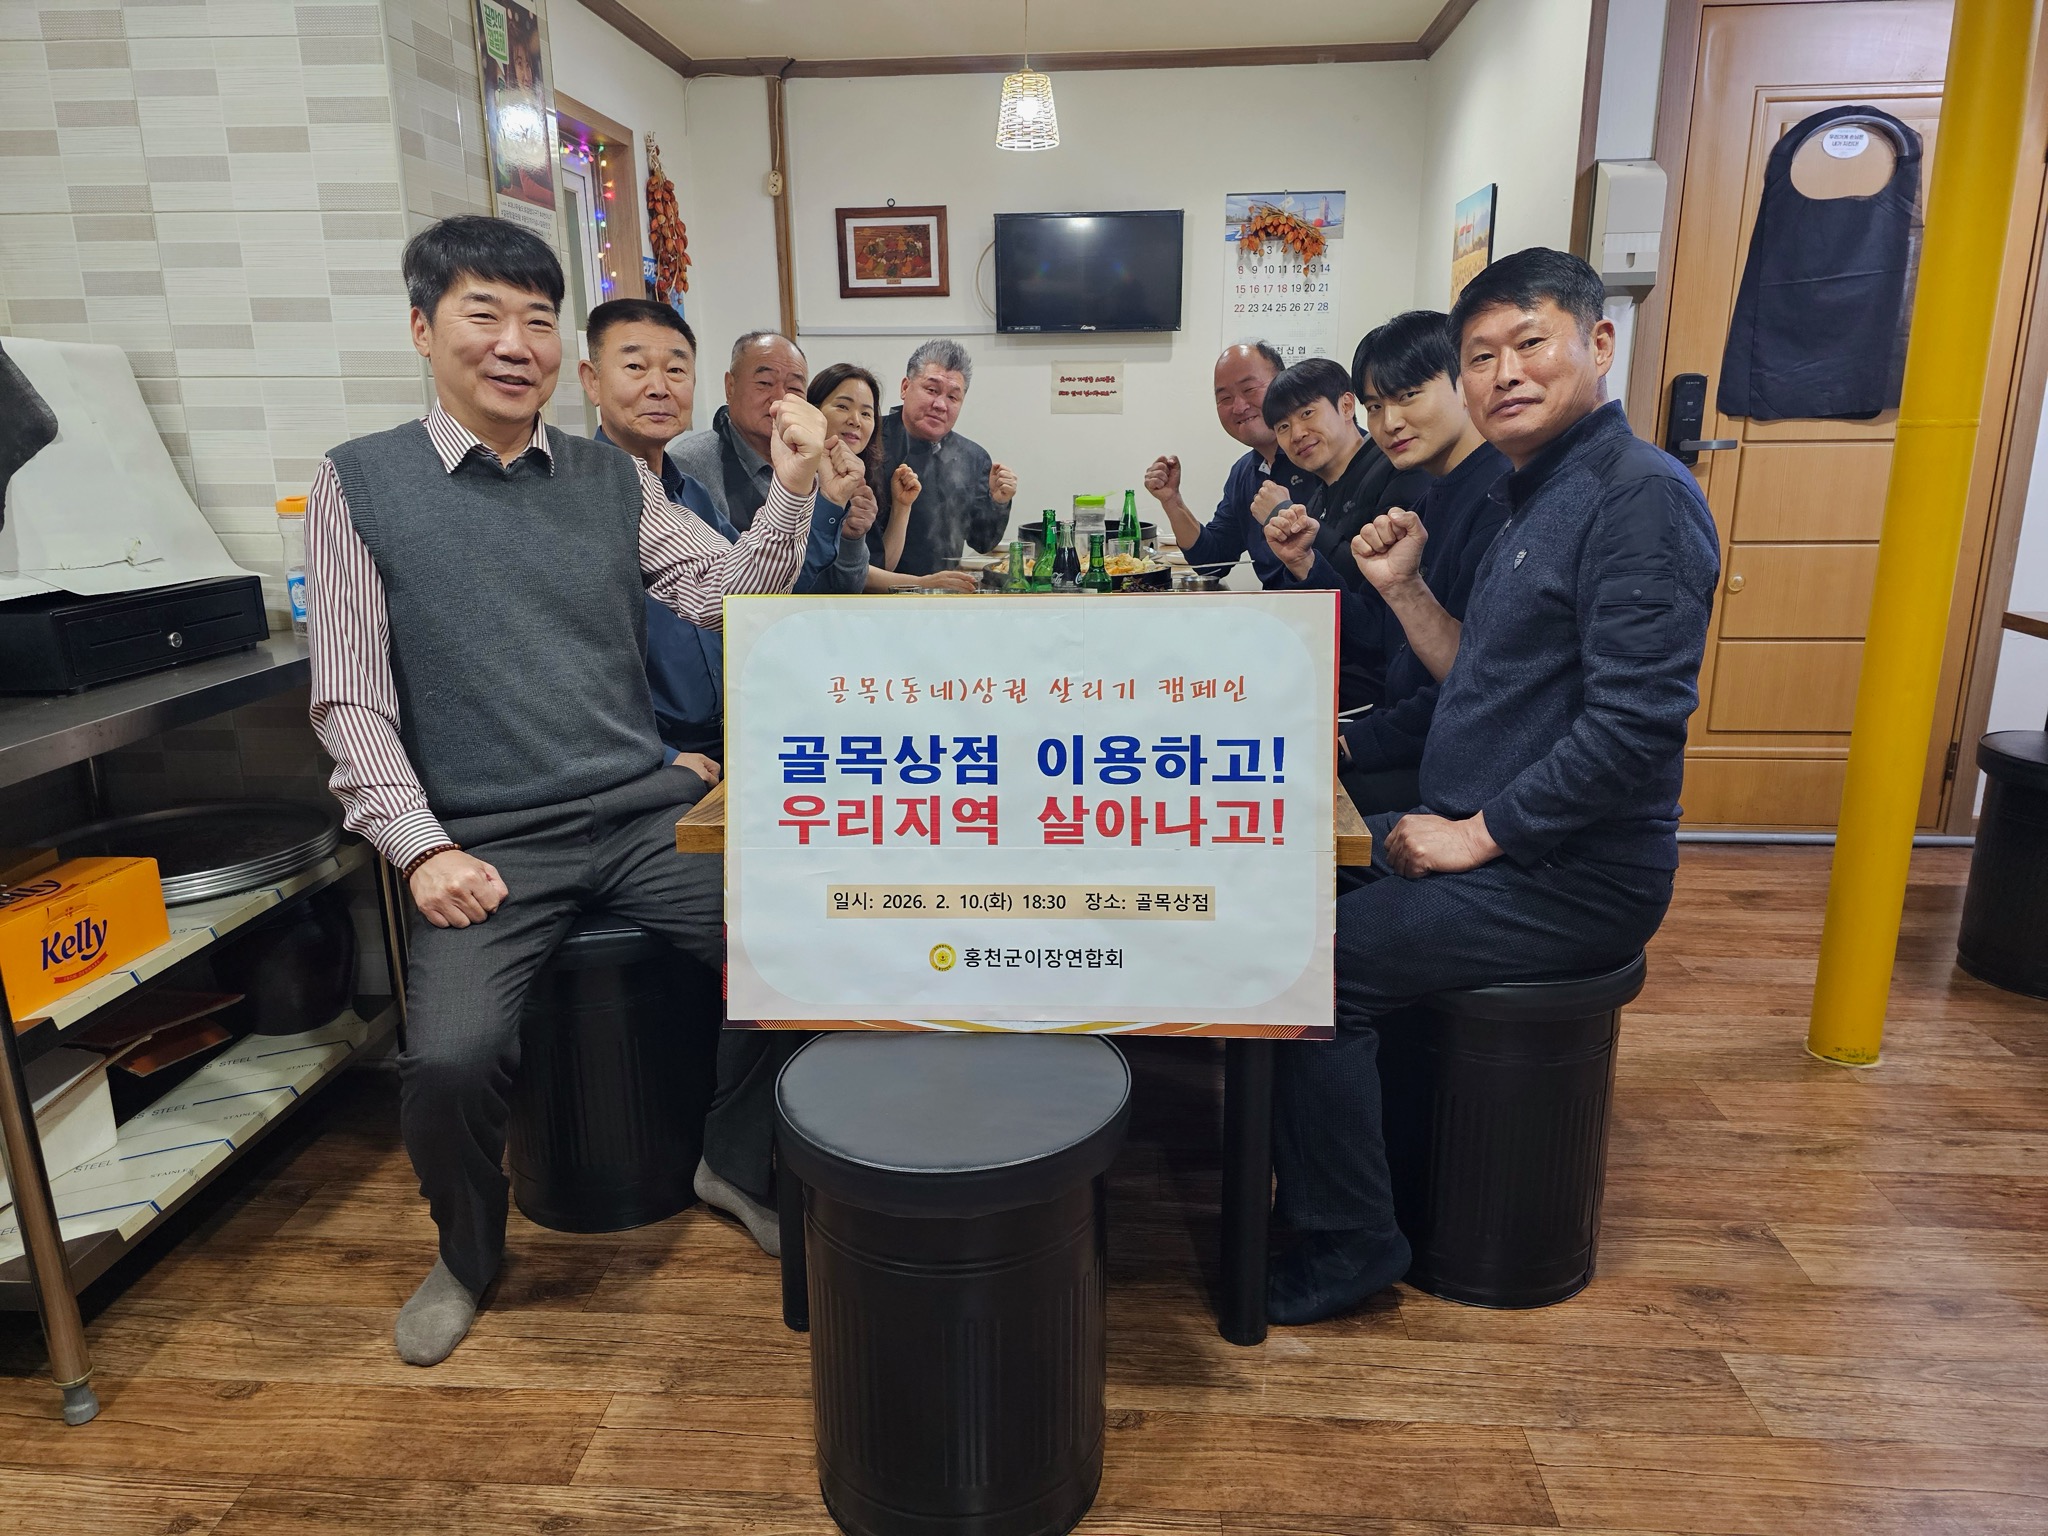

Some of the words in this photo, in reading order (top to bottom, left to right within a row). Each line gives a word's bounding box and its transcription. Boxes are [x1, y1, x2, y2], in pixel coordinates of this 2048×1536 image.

[1266, 245, 1273, 255] 3
[1238, 265, 1244, 275] 8
[1252, 265, 1258, 275] 9
[1264, 264, 1275, 274] 10
[1278, 264, 1288, 274] 11
[1292, 264, 1302, 274] 12
[1320, 263, 1330, 273] 14
[1236, 284, 1246, 294] 15
[1250, 284, 1260, 294] 16
[1264, 284, 1274, 293] 17
[1278, 283, 1288, 293] 18
[1291, 283, 1302, 293] 19
[1304, 283, 1316, 293] 20
[1318, 282, 1329, 292] 21
[1234, 303, 1245, 313] 22
[1248, 303, 1259, 313] 23
[1262, 303, 1273, 313] 24
[1275, 302, 1287, 312] 25
[1289, 302, 1301, 312] 26
[1303, 302, 1315, 312] 27
[1317, 301, 1329, 311] 28
[826, 675, 1029, 705] 골목(동네)상권
[1048, 675, 1136, 705] 살리기
[1158, 674, 1248, 703] 캠페인
[777, 734, 999, 786] 골목상점
[1037, 734, 1285, 786] 이용하고!
[777, 794, 999, 846] 우리지역
[1036, 795, 1285, 847] 살아나고!
[833, 891, 874, 911] 일시:
[882, 894, 927, 909] 2026.
[935, 894, 950, 909] 2.
[959, 891, 1013, 912] 10.(화)
[1022, 894, 1067, 910] 18:30
[1084, 892, 1126, 911] 장소:
[1135, 892, 1209, 912] 골목상점
[41, 917, 108, 971] Kelly
[963, 946, 1124, 969] 홍천군이장연합회
[219, 1056, 251, 1067] STEEL
[152, 1104, 188, 1116] STEEL
[74, 1160, 113, 1173] STEEL
